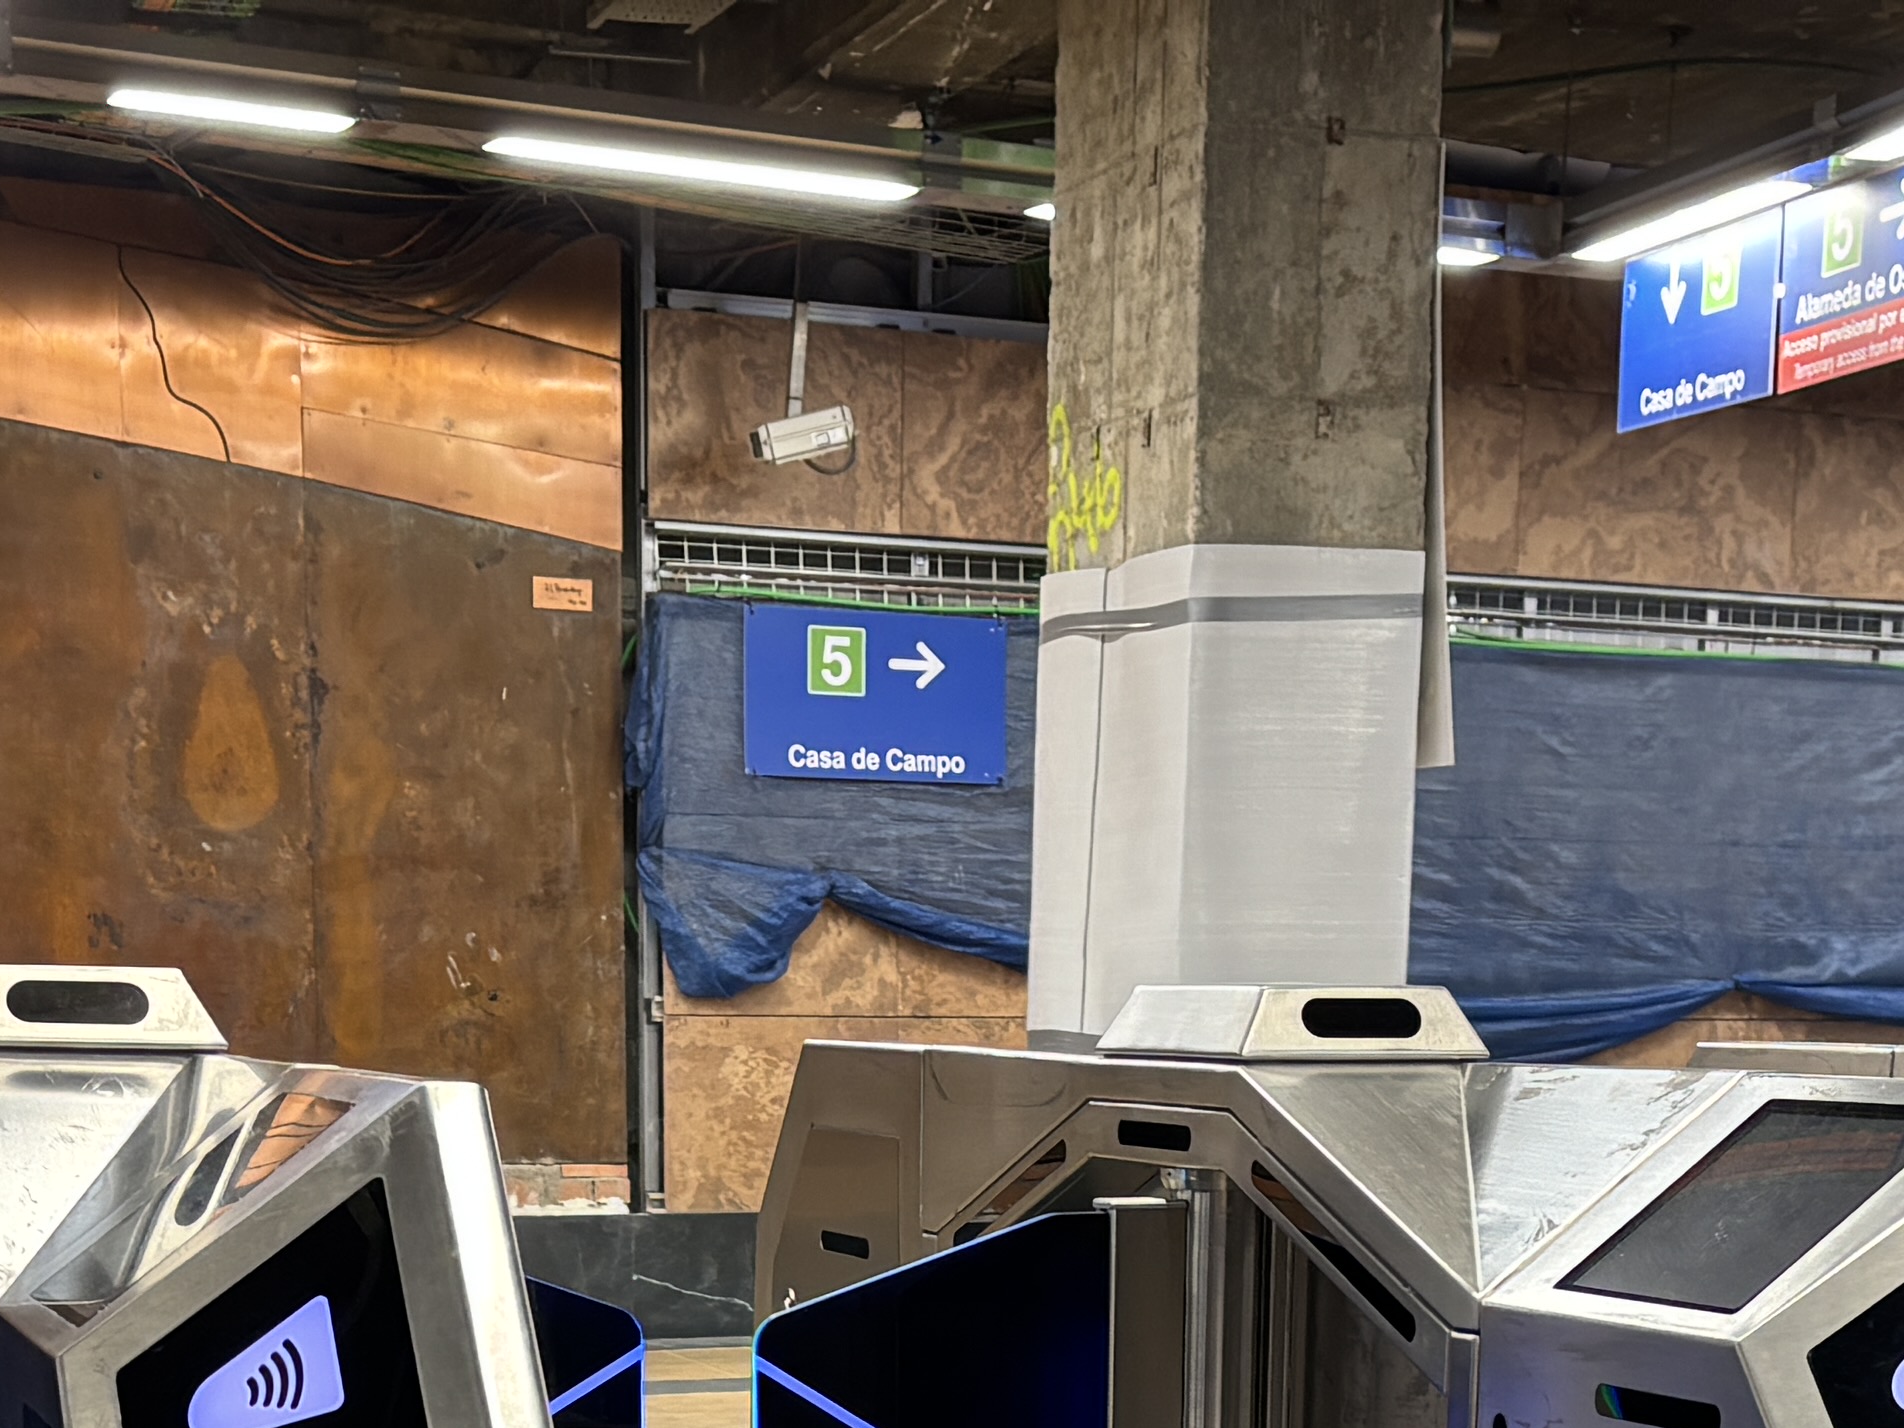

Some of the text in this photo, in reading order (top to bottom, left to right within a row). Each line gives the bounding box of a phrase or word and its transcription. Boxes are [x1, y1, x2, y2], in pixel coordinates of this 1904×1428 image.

[1795, 280, 1862, 325] Alameda
[1864, 272, 1886, 302] de
[1639, 368, 1745, 416] Casa de Campo
[820, 635, 853, 687] 5
[787, 744, 966, 778] Casa de Campo
